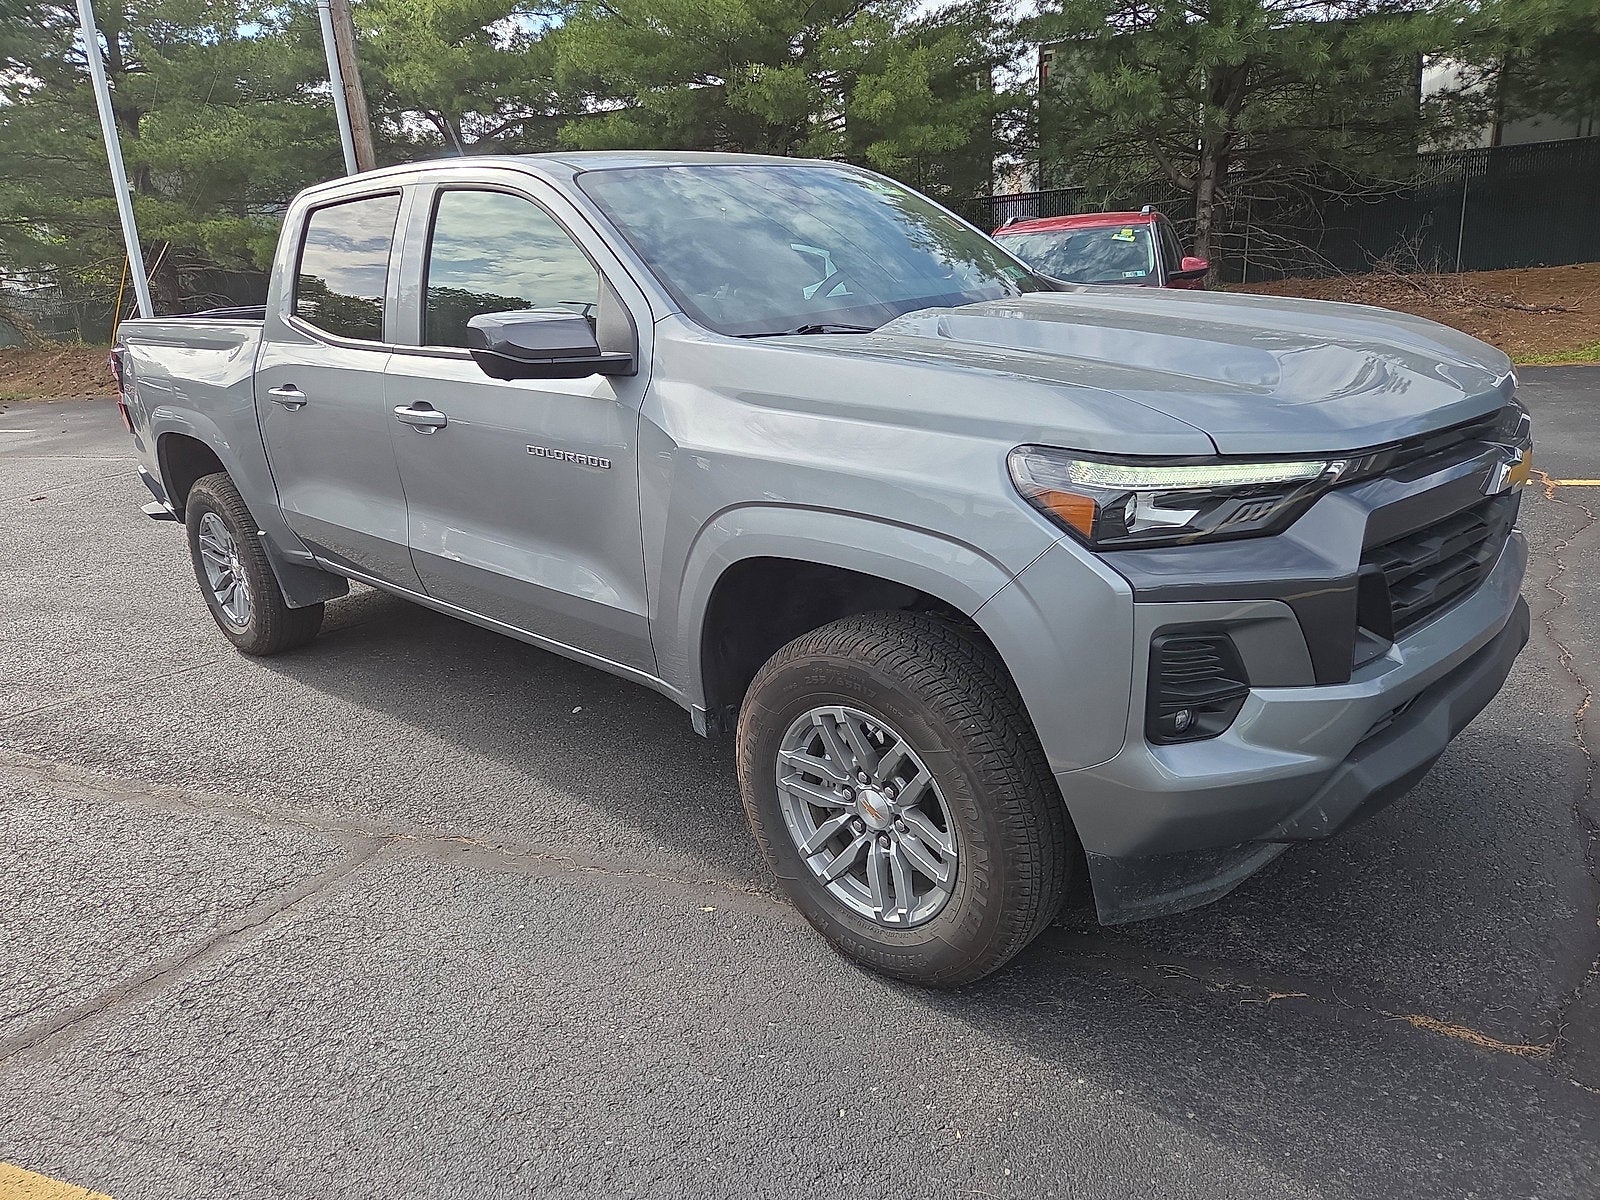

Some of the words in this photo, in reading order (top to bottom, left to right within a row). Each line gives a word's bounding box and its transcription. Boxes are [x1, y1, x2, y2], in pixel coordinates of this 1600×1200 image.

[525, 444, 612, 469] COLORADO
[804, 674, 877, 698] 255/65R17
[943, 766, 990, 942] WRANGLER
